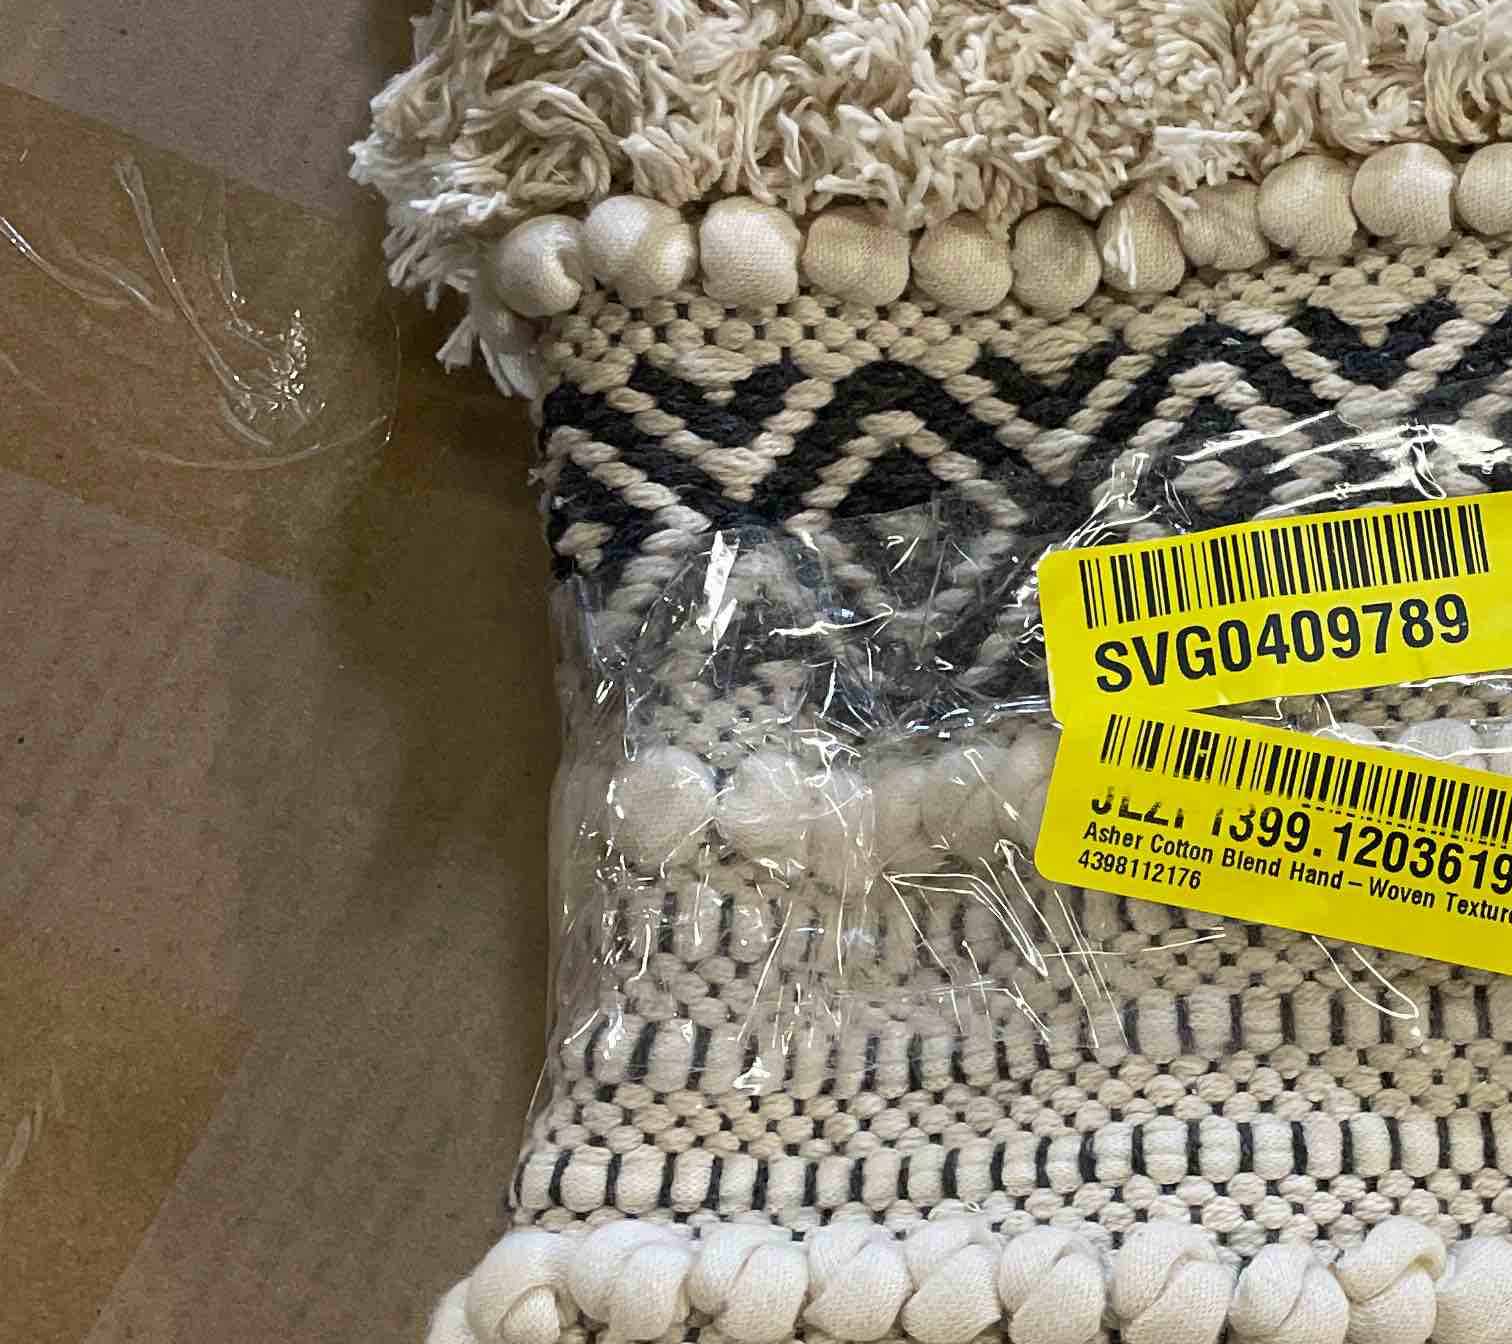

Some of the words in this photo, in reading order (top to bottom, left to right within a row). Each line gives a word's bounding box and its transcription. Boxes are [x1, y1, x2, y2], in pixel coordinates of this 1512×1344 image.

[1094, 593, 1469, 693] SVG0409789
[1077, 849, 1202, 890] 4398112176
[1082, 821, 1144, 850] Asher
[1150, 833, 1214, 865] Cotton
[1221, 847, 1282, 878] Blend
